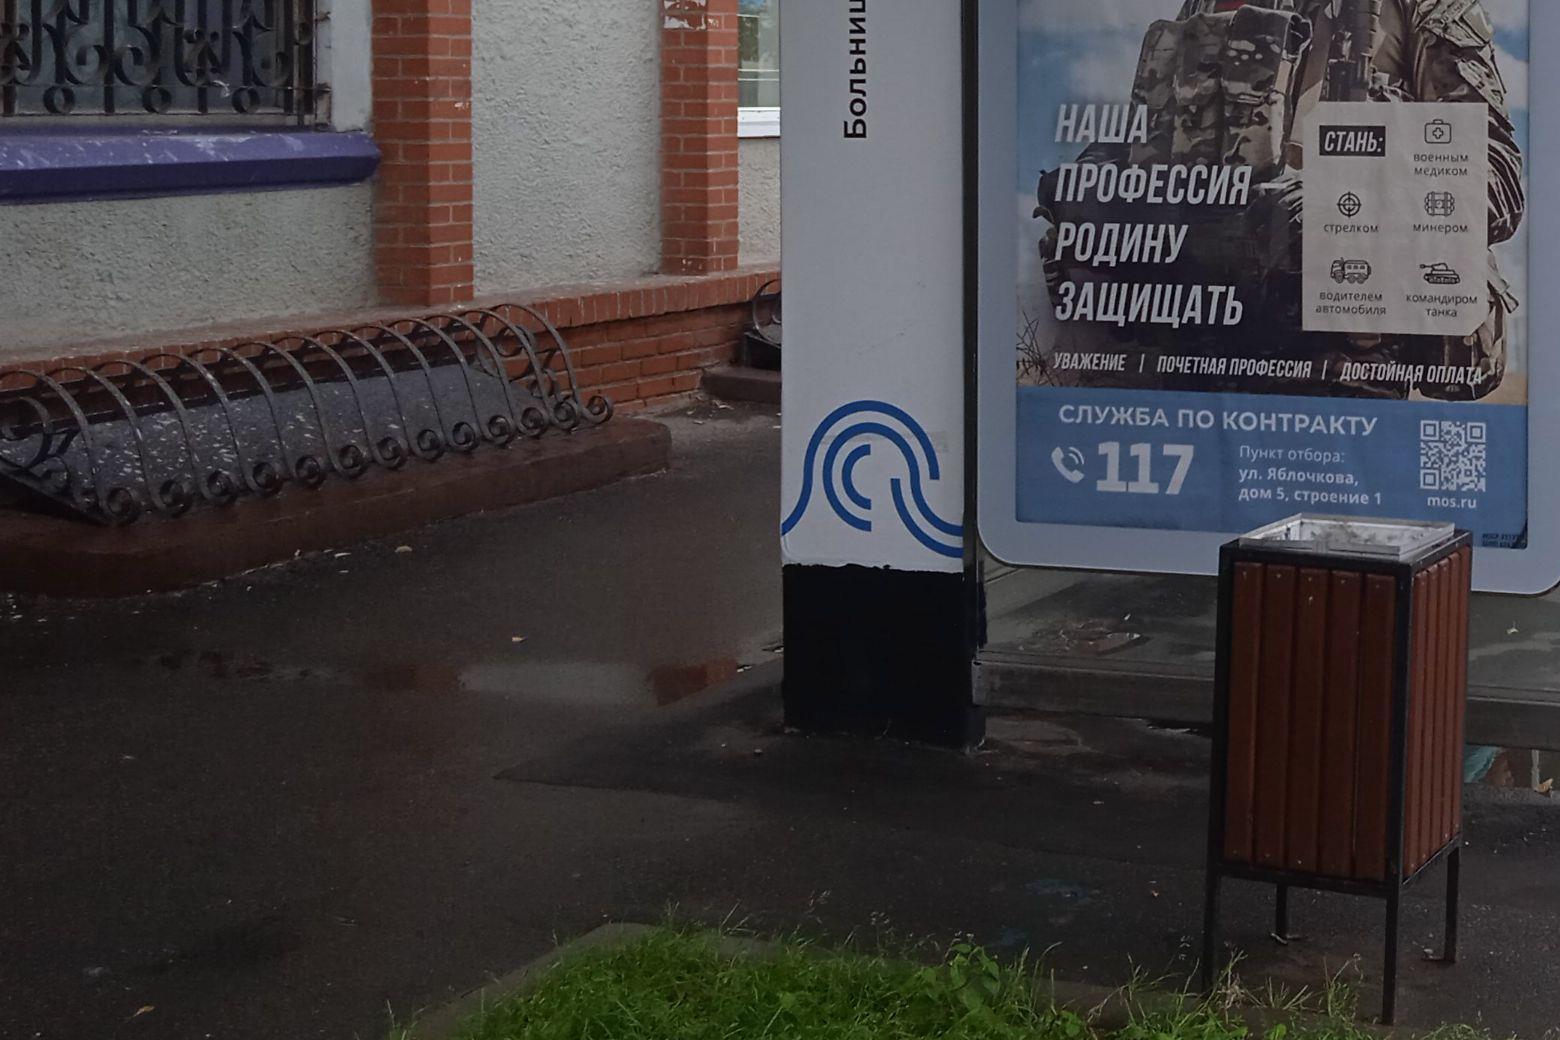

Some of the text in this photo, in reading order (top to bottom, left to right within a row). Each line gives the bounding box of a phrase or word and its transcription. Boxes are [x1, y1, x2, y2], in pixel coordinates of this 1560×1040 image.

[1055, 103, 1149, 144] НАША
[1324, 130, 1384, 154] СТАНЬ:
[1413, 154, 1469, 163] военным
[1414, 166, 1468, 176] медиком
[1054, 162, 1253, 206] ПРОФЕССИЯ
[1323, 223, 1380, 235] стрелком
[1413, 223, 1469, 235] минером
[1054, 221, 1189, 268] РОДИНУ
[1055, 280, 1244, 330] ЗАЩИЩАТЬ
[1319, 291, 1383, 302] водителем
[1406, 294, 1478, 306] командиром
[1315, 305, 1387, 316] автомобиля
[1427, 308, 1458, 318] танка
[1053, 352, 1483, 386] УВАЖЕНИЕ ПОЧЕТНАЯ ПРОФЕССИЯ ДОСТОЙНАЯ ОПЛАТА
[1058, 404, 1378, 436] СЛУЖБА ПО КОНТРАКТУ
[1239, 445, 1346, 464] Пункт отбора:
[1096, 441, 1195, 496] 117
[1239, 468, 1359, 487] ул. Яблочкова,
[1238, 488, 1382, 505] дом 5, строение 1
[1427, 496, 1477, 510] mos.ru
